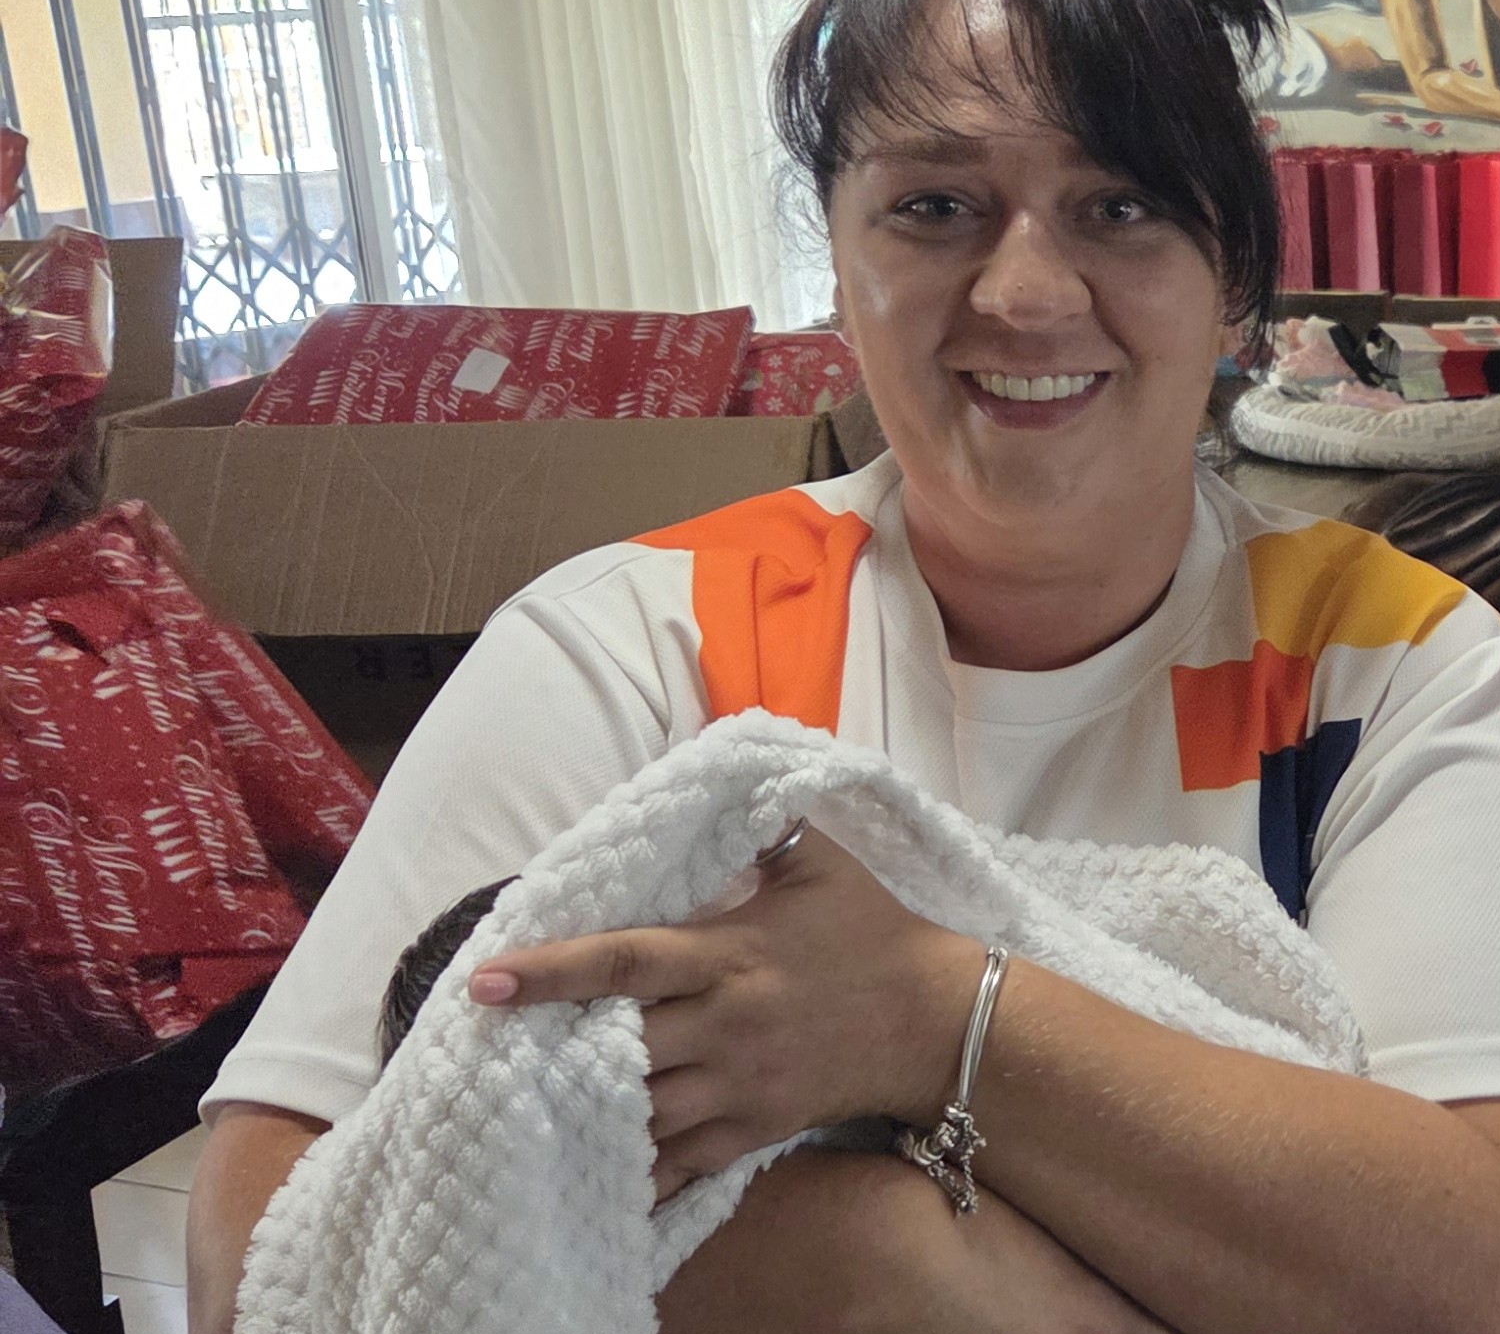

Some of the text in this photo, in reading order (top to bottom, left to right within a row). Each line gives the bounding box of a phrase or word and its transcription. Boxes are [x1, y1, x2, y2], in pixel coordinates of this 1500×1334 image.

[355, 353, 407, 422] Merry
[76, 816, 149, 934] Merry
[173, 739, 246, 911] Christmas
